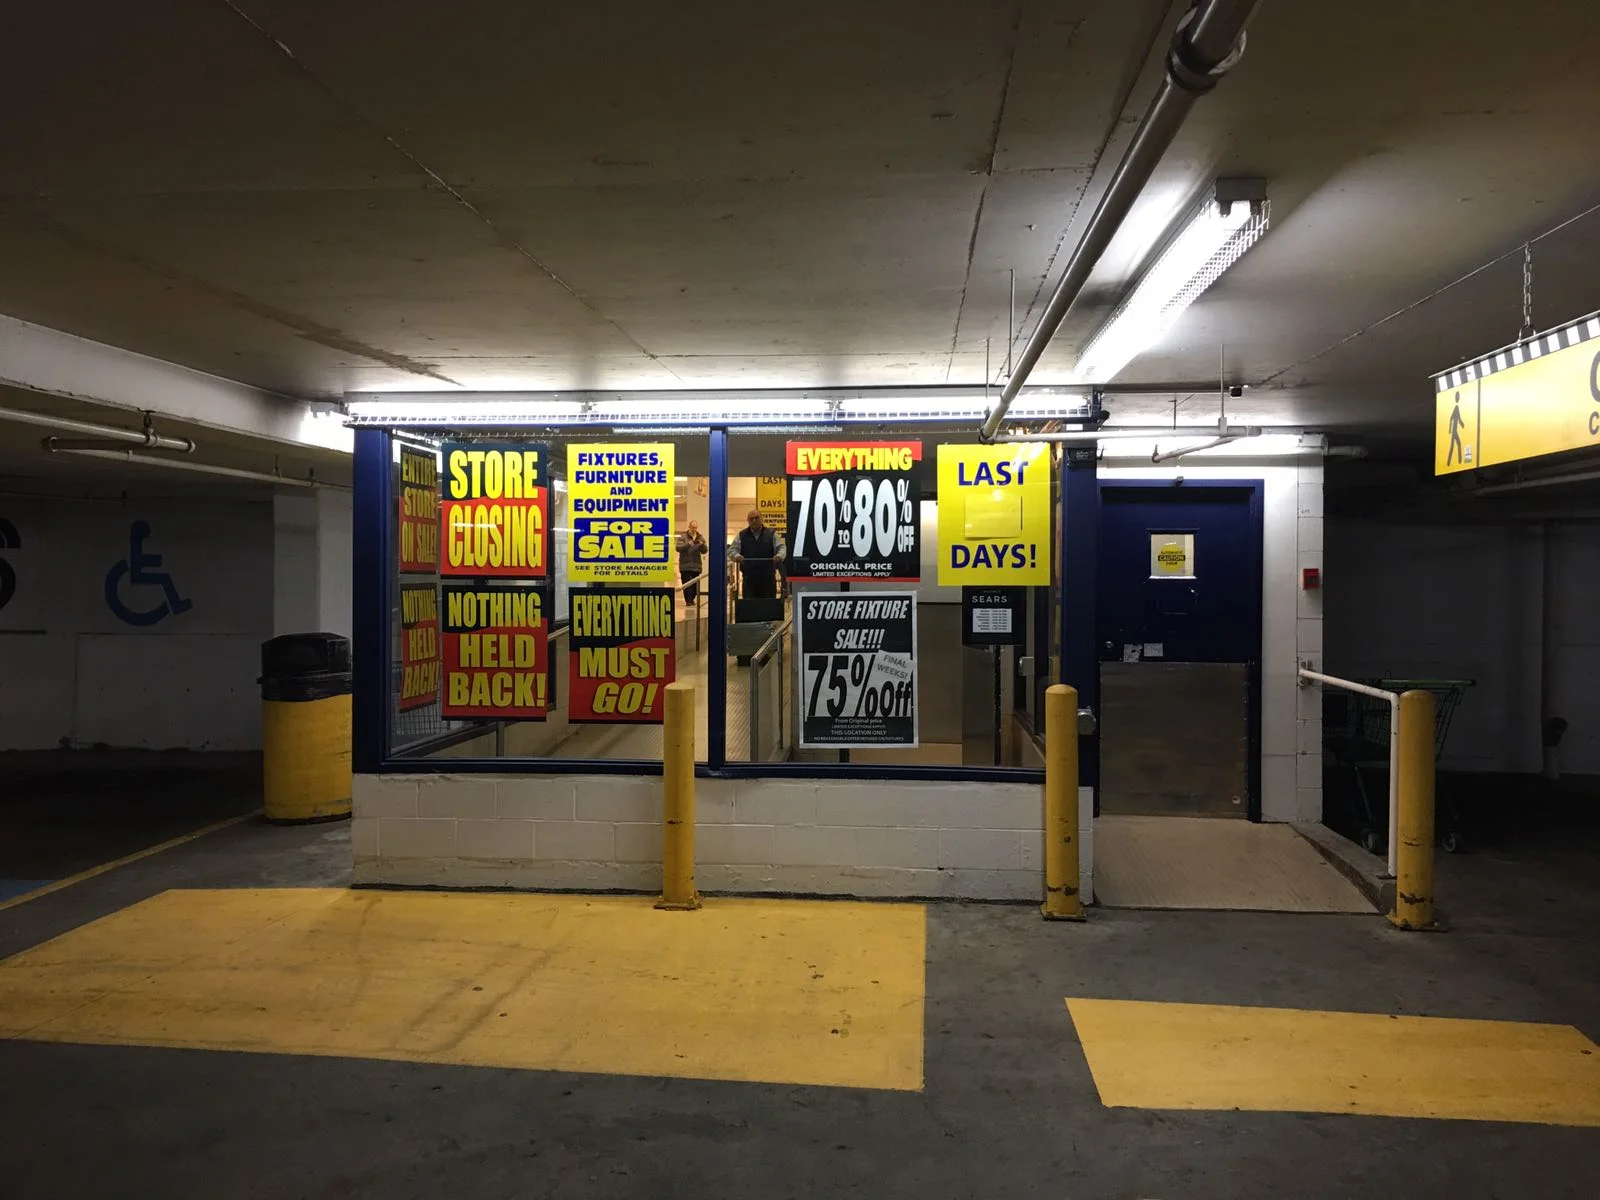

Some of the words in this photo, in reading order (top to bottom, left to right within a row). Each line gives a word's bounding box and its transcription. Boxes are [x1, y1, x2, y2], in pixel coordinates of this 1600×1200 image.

[402, 451, 437, 488] ENTIRE
[578, 453, 663, 467] FIXTURES,
[797, 447, 913, 471] EVERYTHING
[957, 461, 1029, 486] LAST
[449, 450, 538, 499] STORE
[575, 471, 667, 483] FURNITURE
[404, 486, 436, 519] STORE
[610, 487, 633, 495] AND
[760, 500, 785, 508] DAYS!
[574, 499, 669, 514] EQUIPMENT
[792, 478, 852, 557] 70%
[838, 529, 850, 544] TO
[852, 478, 913, 558] 80%
[897, 525, 915, 553] OFF
[402, 520, 414, 563] ON
[448, 504, 542, 567] CLOSING
[590, 521, 653, 534] FOR
[578, 535, 665, 559] SALE
[950, 544, 1037, 569] DAYS!
[402, 589, 436, 623] NOTHING
[448, 592, 541, 628] NOTHING
[807, 600, 853, 620] STORE
[853, 600, 909, 619] FIXTURE
[971, 595, 1007, 603] SEARS
[573, 595, 671, 637] EVERYTHING
[409, 627, 436, 661] HELD
[459, 634, 535, 668] HELD
[833, 628, 885, 649] SALE!!!
[580, 648, 669, 678] MUST
[884, 654, 907, 668] FINAL
[402, 660, 440, 699] BACK!
[448, 672, 547, 707] BACK!
[592, 682, 659, 714] GO!
